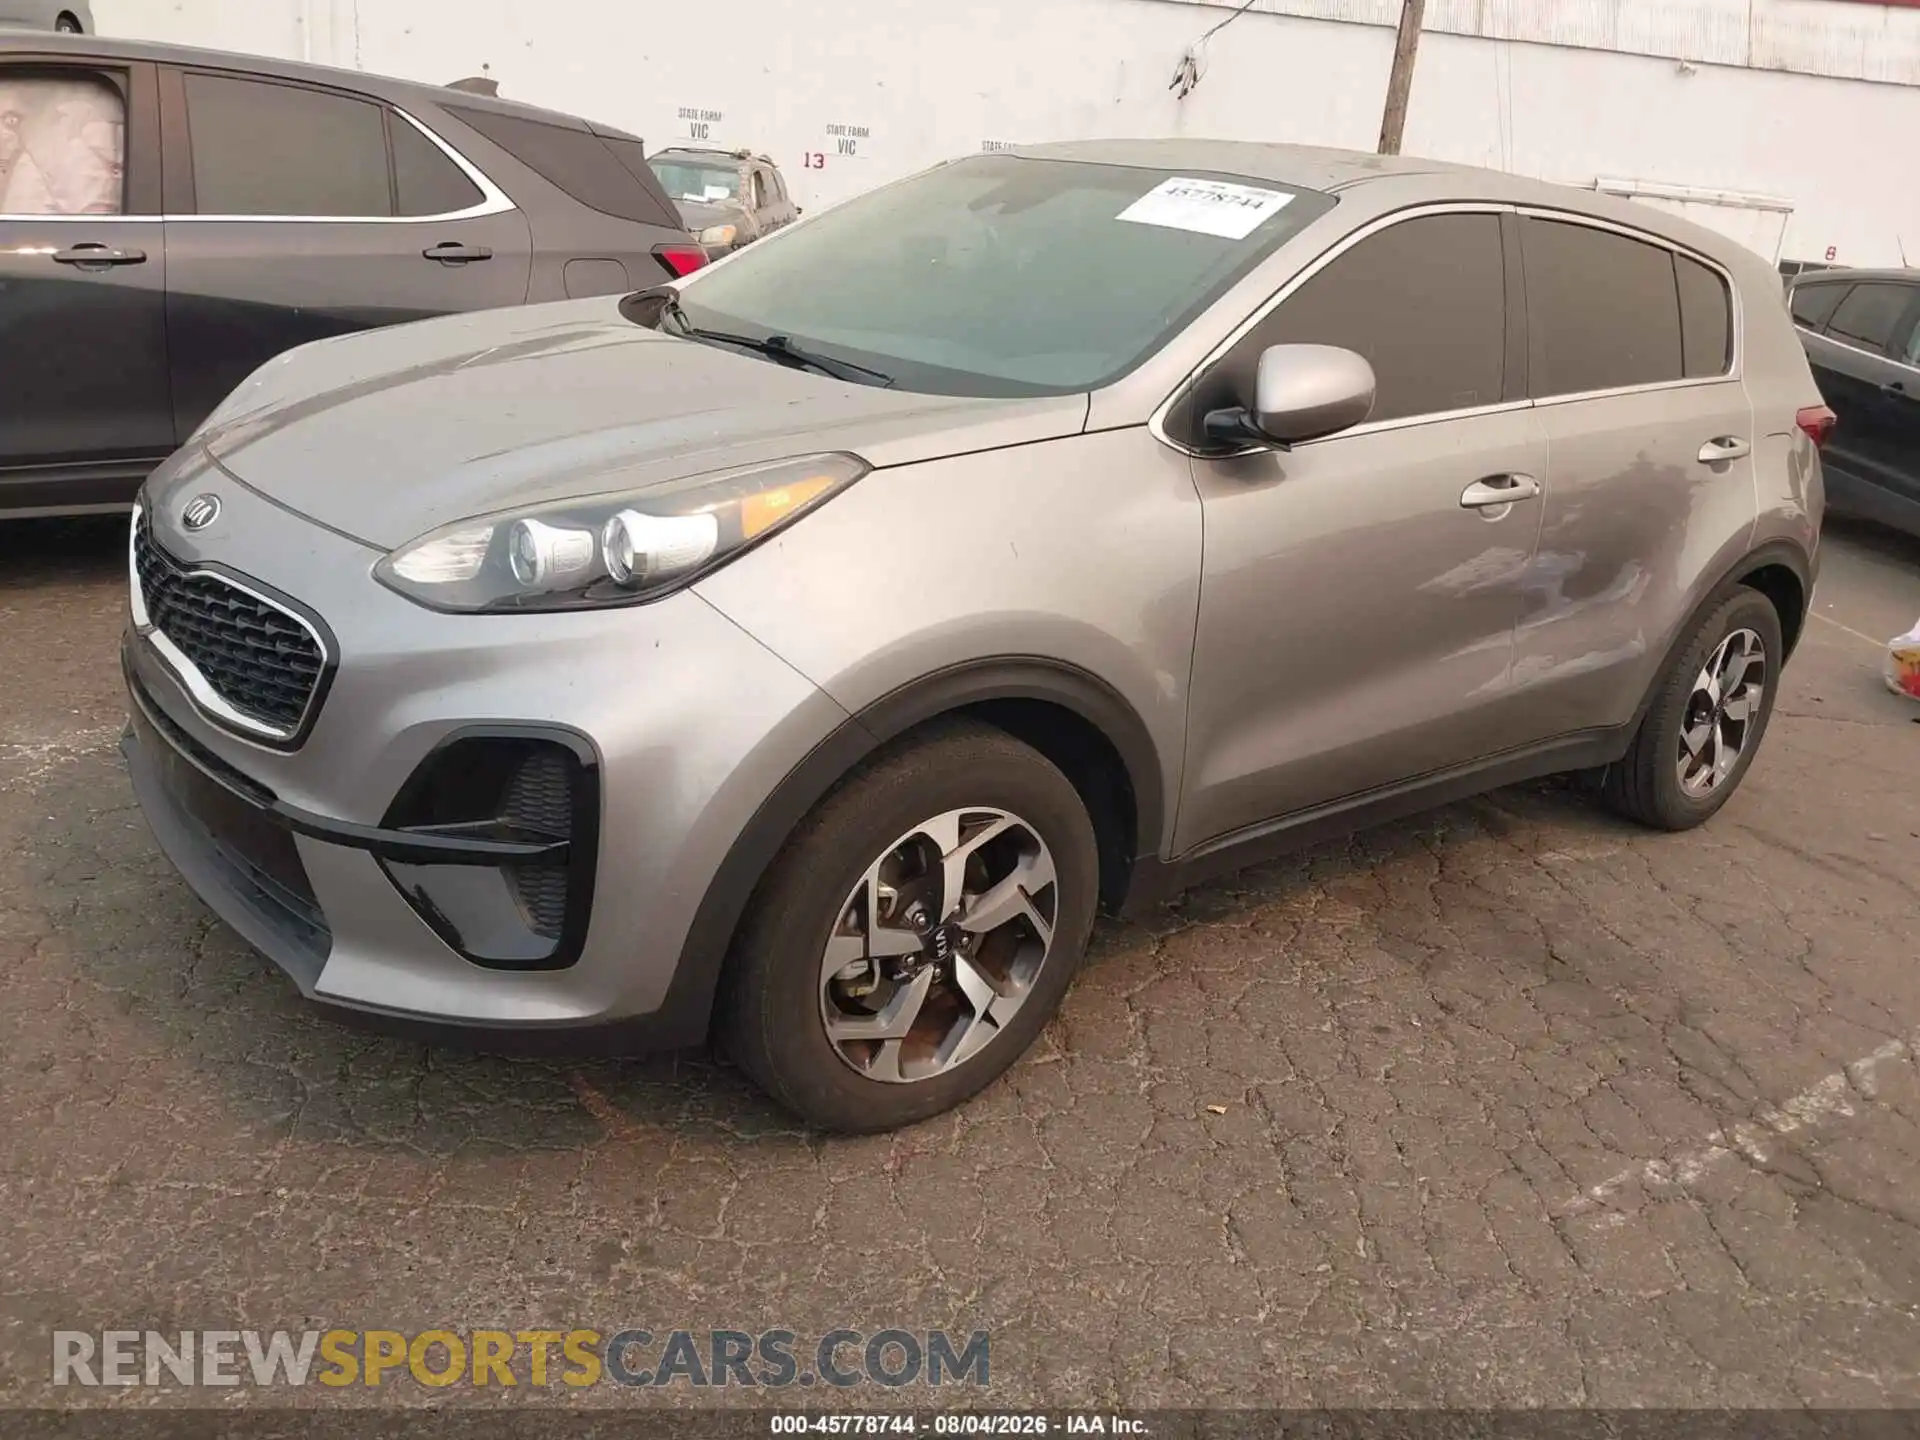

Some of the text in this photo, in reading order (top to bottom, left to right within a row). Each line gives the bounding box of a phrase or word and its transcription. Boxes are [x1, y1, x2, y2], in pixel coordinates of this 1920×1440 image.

[678, 107, 722, 121] STATE FARM
[690, 122, 709, 139] VIC
[826, 124, 870, 138] STATE FARM
[838, 138, 856, 155] VIC
[804, 152, 825, 169] 13
[1165, 187, 1265, 210] 45778744
[935, 929, 948, 958] KIA
